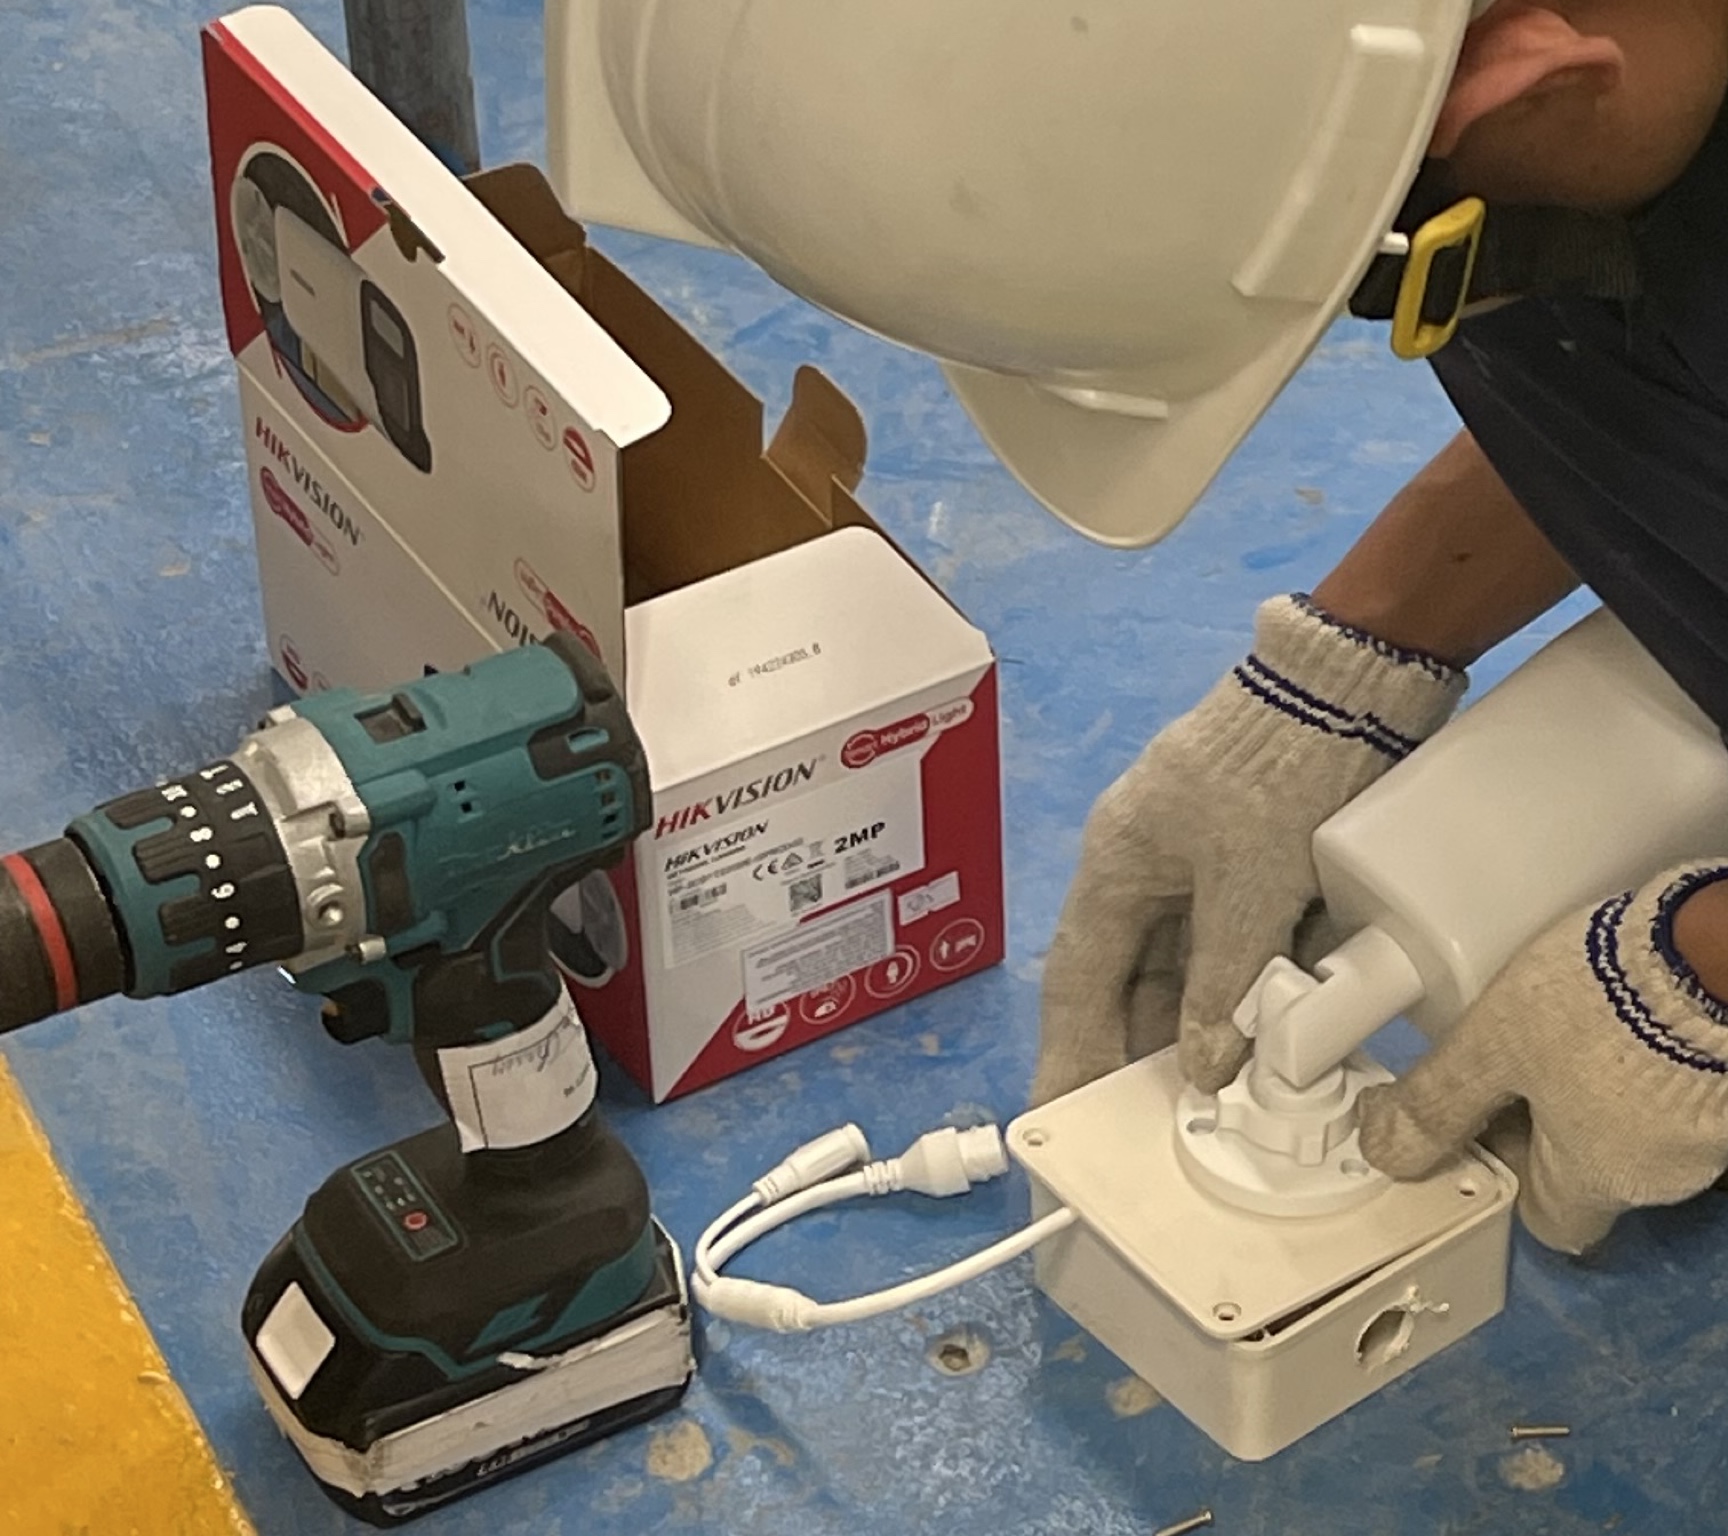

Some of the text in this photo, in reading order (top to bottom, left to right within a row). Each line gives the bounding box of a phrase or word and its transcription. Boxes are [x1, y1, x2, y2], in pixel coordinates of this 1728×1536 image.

[256, 416, 361, 546] HIKVISION
[654, 758, 819, 840] HIKVISION
[664, 819, 769, 872] HIKVISION
[834, 822, 886, 854] 2MP
